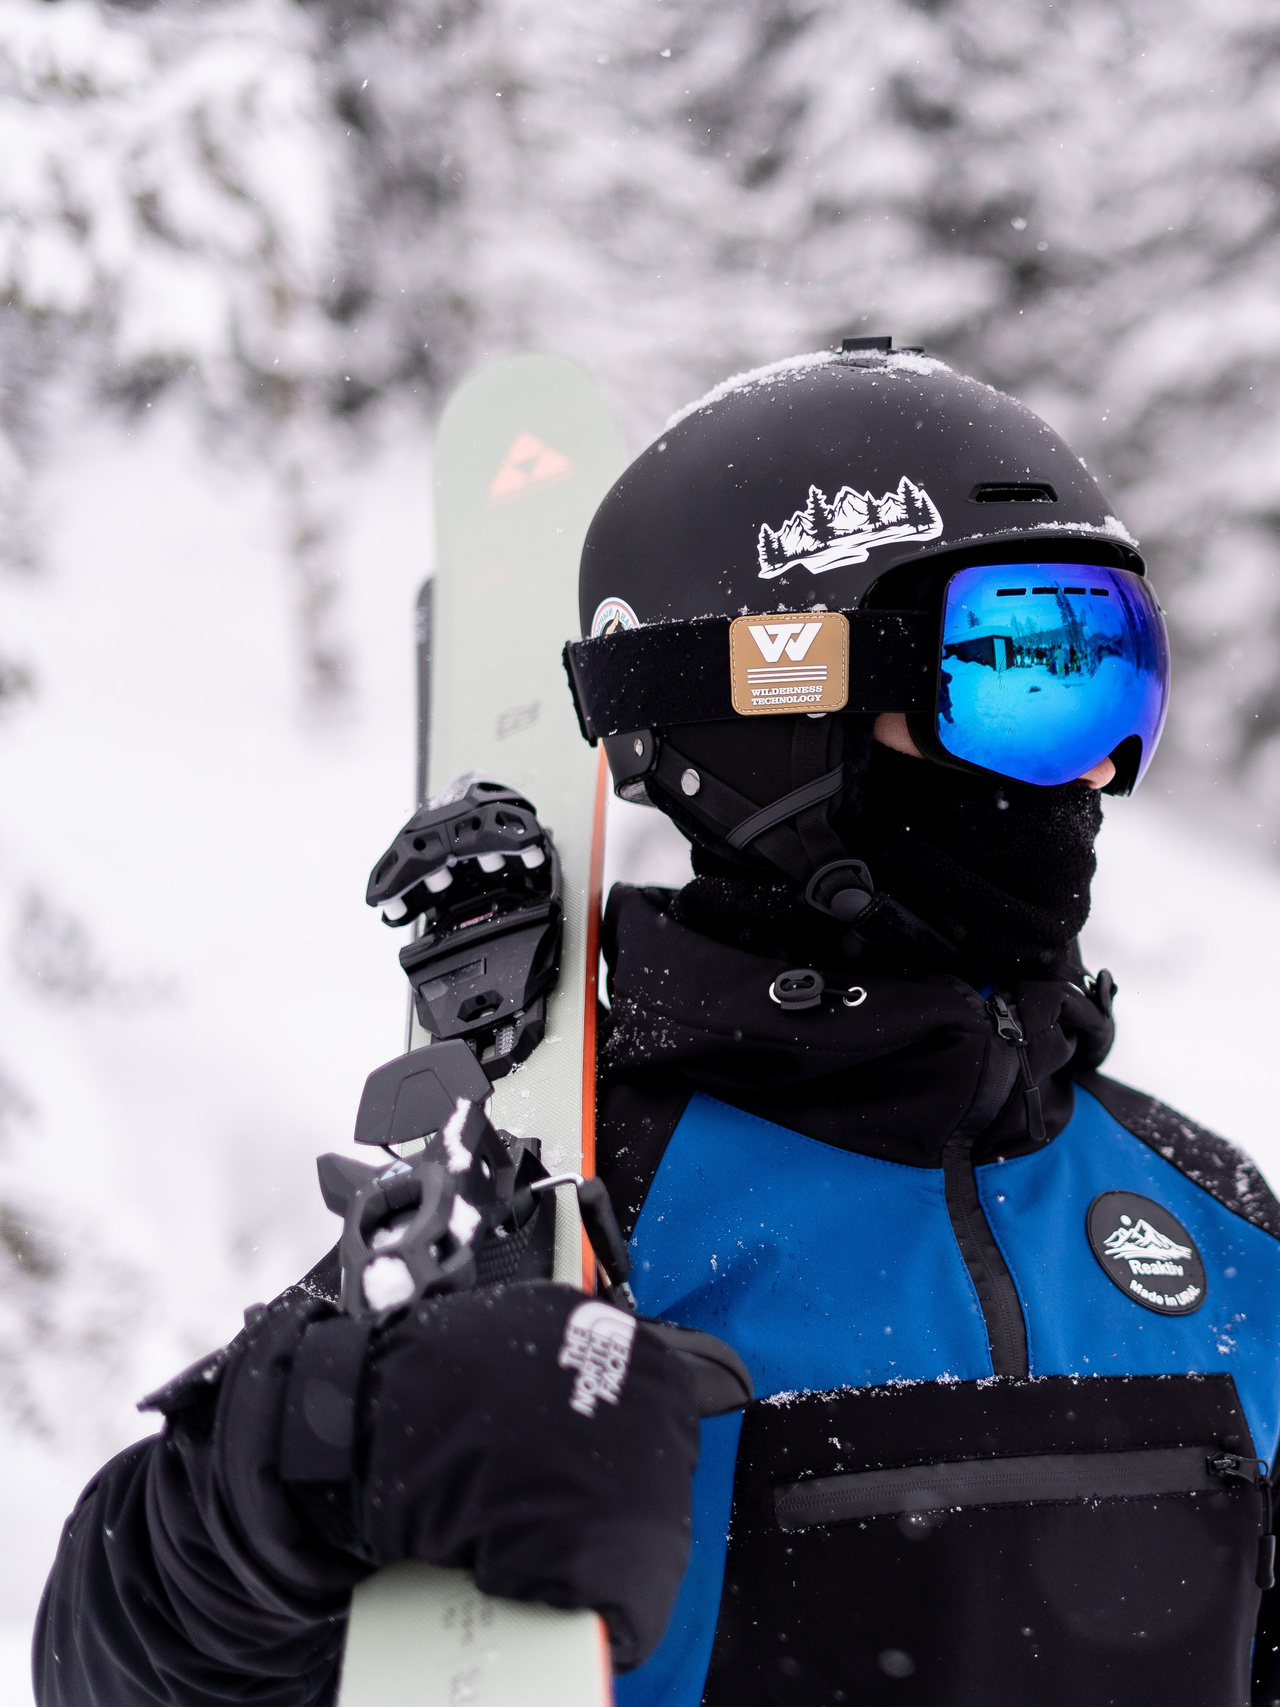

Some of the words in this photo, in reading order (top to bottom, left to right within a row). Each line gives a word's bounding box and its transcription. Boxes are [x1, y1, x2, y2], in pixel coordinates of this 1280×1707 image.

[751, 685, 823, 696] WILDERNESS
[751, 695, 823, 706] TECHNOLOGY
[1128, 1260, 1184, 1276] Reaktiv
[1129, 1279, 1164, 1305] Made
[1164, 1294, 1178, 1306] in
[1175, 1284, 1201, 1306] URAL
[559, 1325, 590, 1369] THE
[569, 1333, 612, 1417] NORTH
[597, 1341, 630, 1405] FACE
